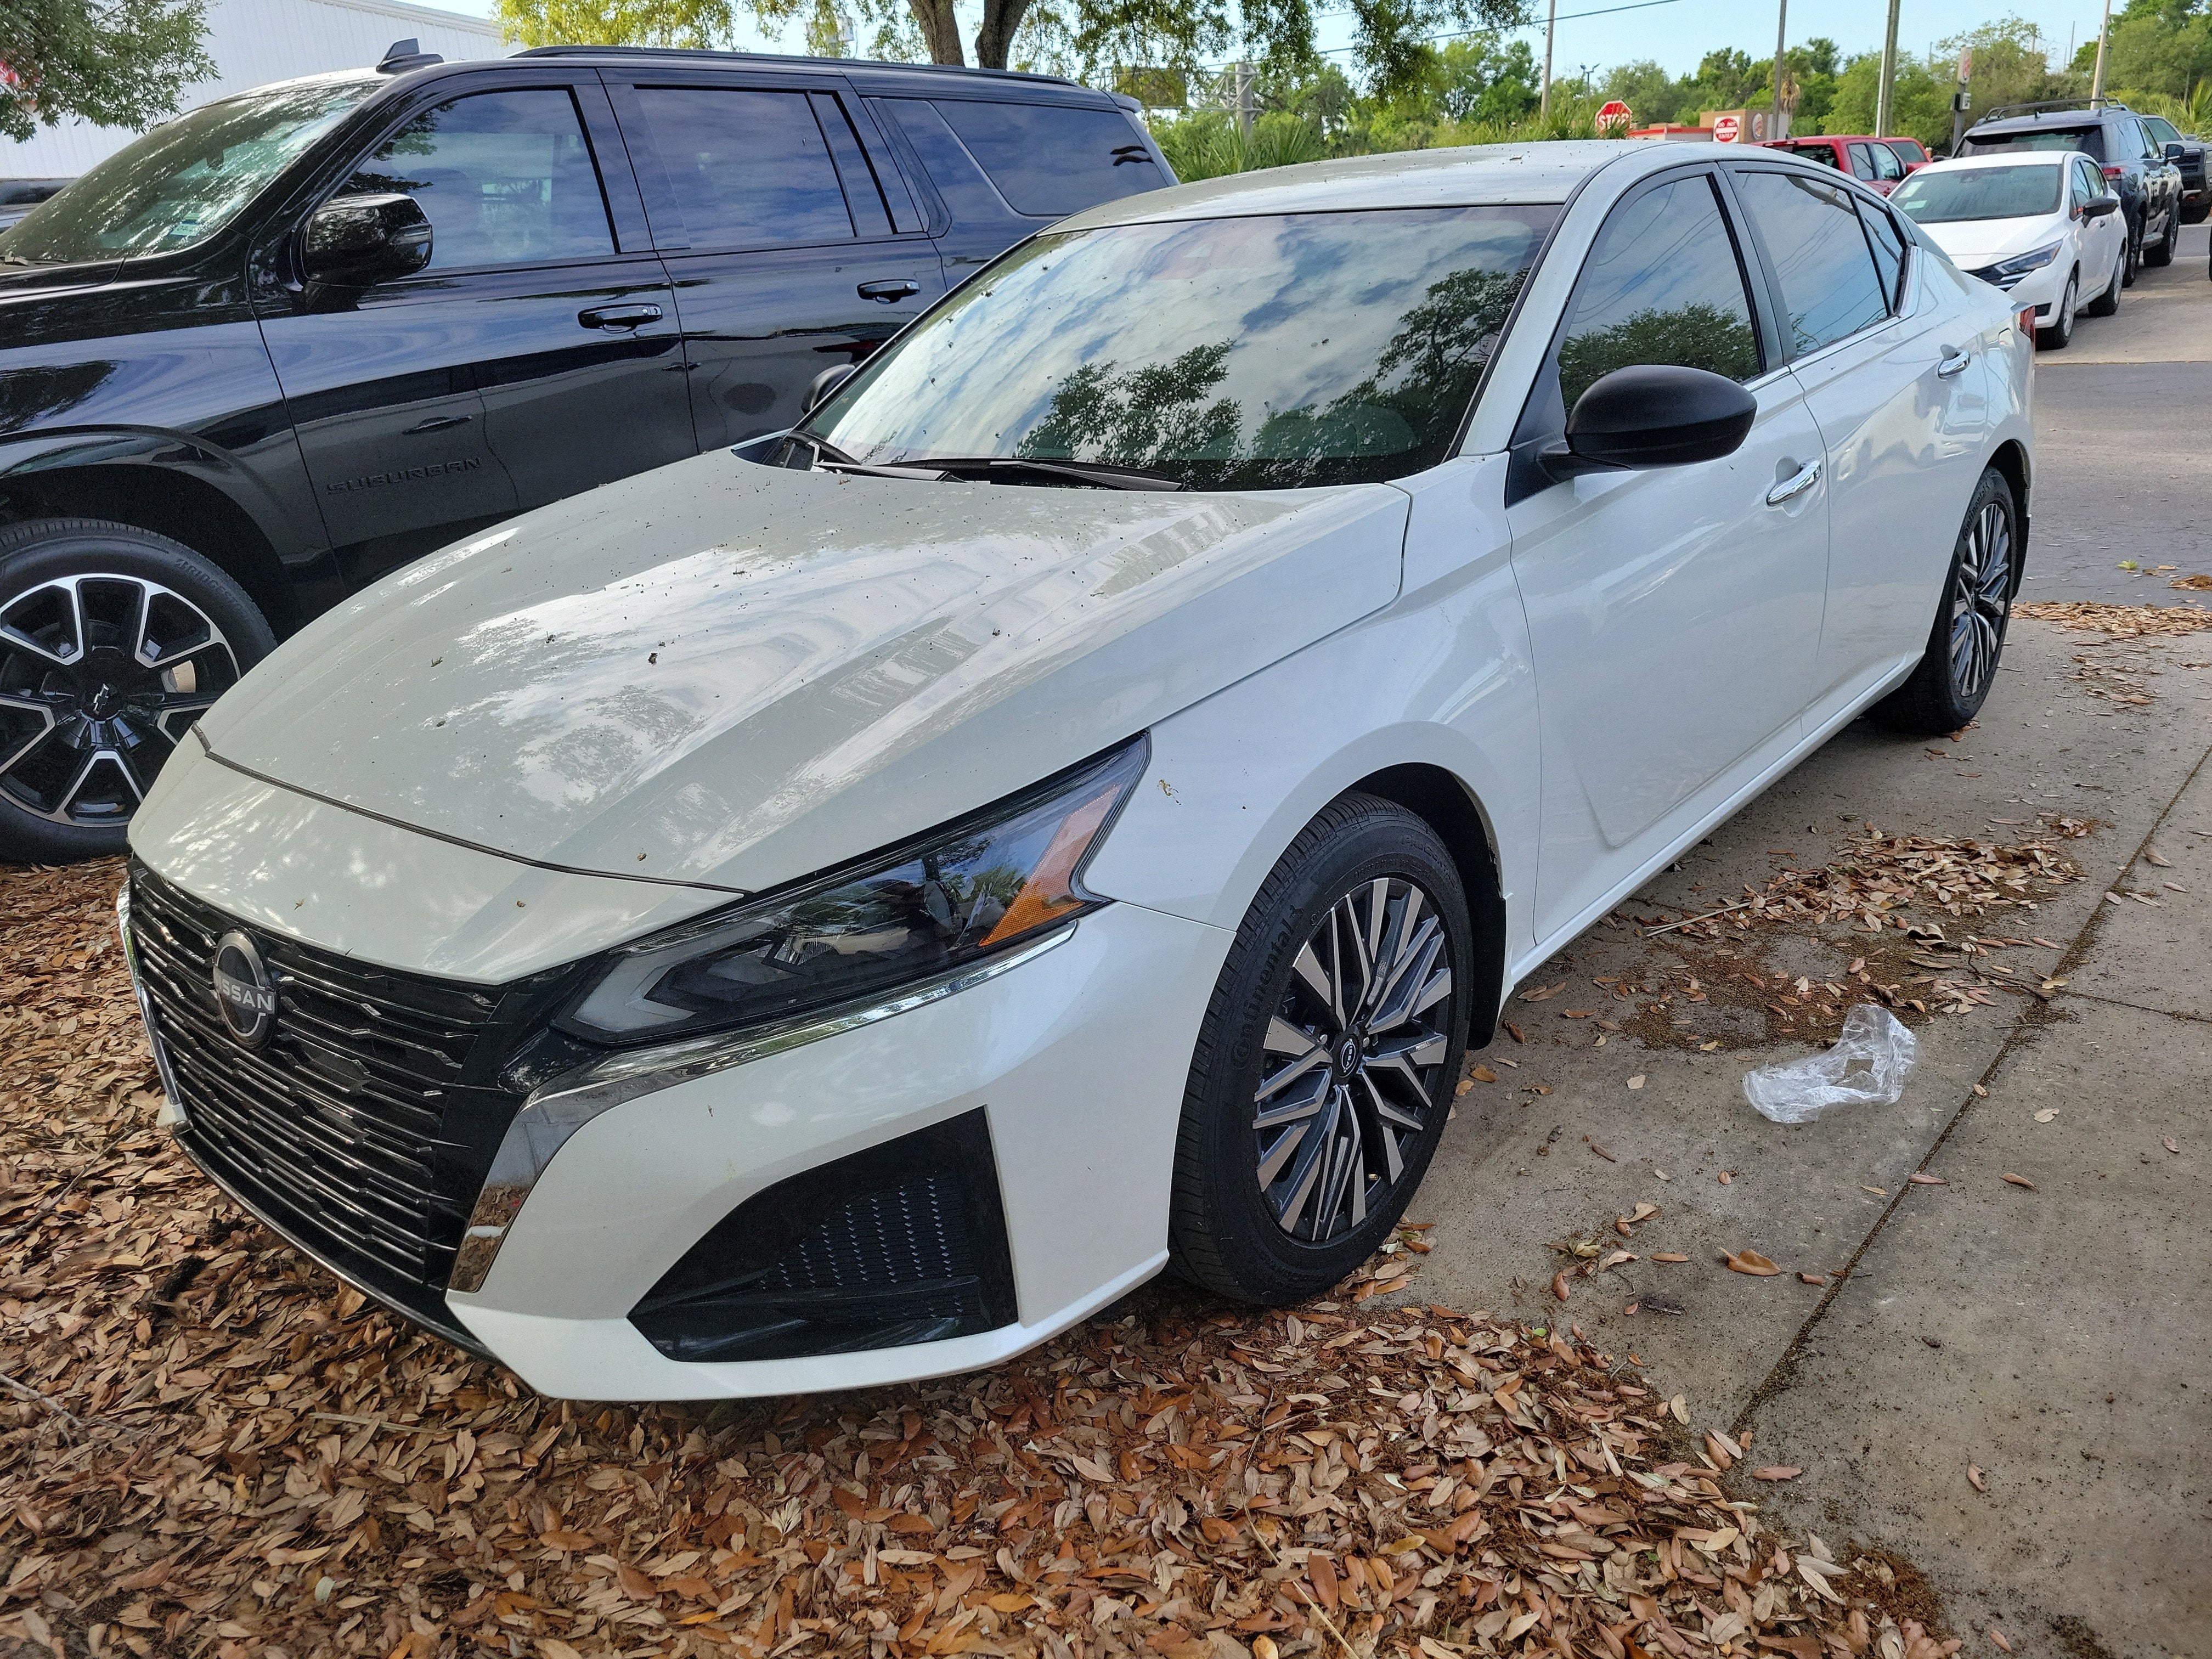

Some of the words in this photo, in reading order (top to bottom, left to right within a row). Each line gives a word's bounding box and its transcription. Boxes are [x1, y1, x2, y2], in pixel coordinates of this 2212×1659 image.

[1598, 113, 1629, 130] STOP
[326, 456, 483, 495] SUBURBAN
[1231, 916, 1295, 1069] Continental
